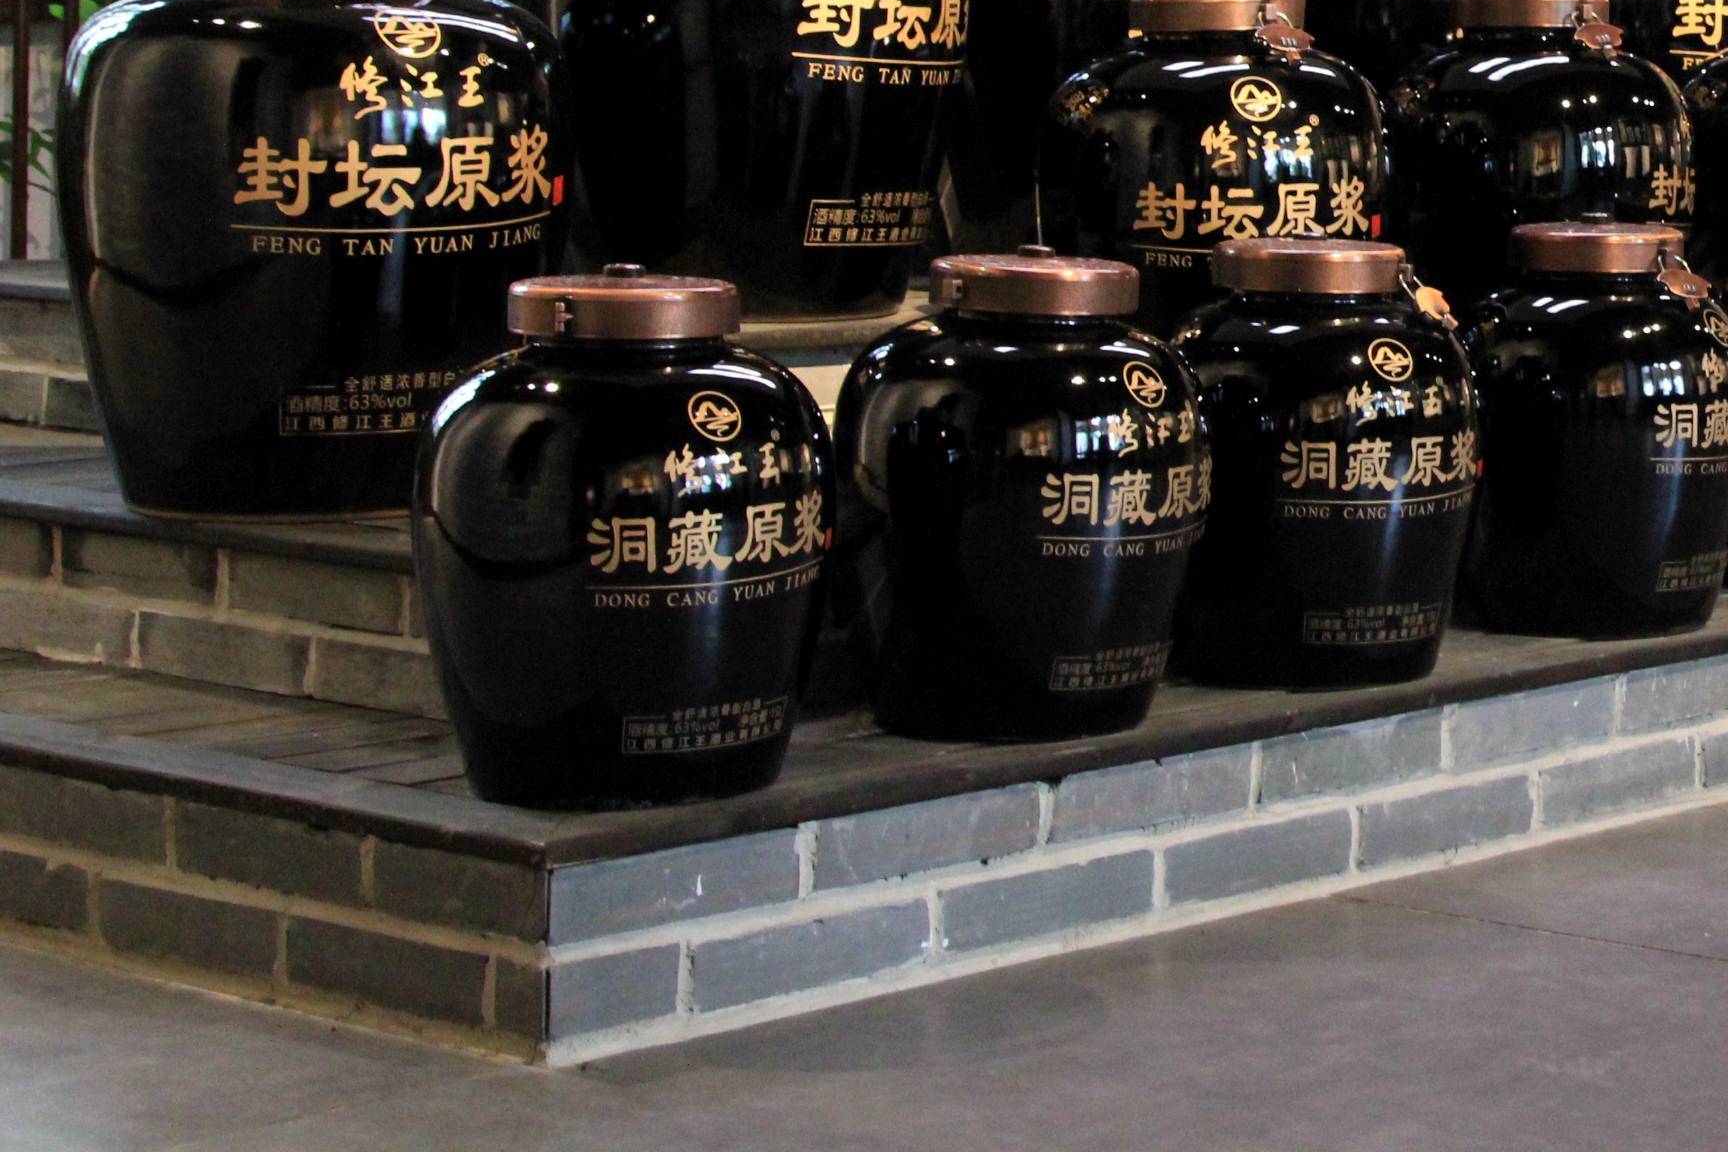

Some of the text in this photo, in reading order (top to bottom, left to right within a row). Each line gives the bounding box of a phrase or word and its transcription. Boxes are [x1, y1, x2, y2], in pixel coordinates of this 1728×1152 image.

[340, 55, 484, 119] 修江王
[808, 63, 865, 82] FENG
[878, 67, 911, 84] TAN
[1201, 120, 1314, 168] 修江王
[233, 124, 552, 216] 封坛原浆
[1133, 176, 1369, 240] 封坛原浆
[253, 224, 541, 255] FENG TAN YUAN JIANG
[1145, 252, 1193, 268] FENG
[1280, 427, 1477, 491] 洞藏原浆
[1284, 506, 1330, 518] DONG
[1344, 507, 1387, 519] CANG
[1399, 502, 1435, 517] YUAN
[586, 492, 825, 574] 洞藏原浆
[1042, 543, 1090, 557] DONG
[1103, 542, 1144, 557] CANG
[594, 594, 650, 608] DONG
[667, 590, 719, 607] CANG
[733, 580, 776, 601] YUAN
